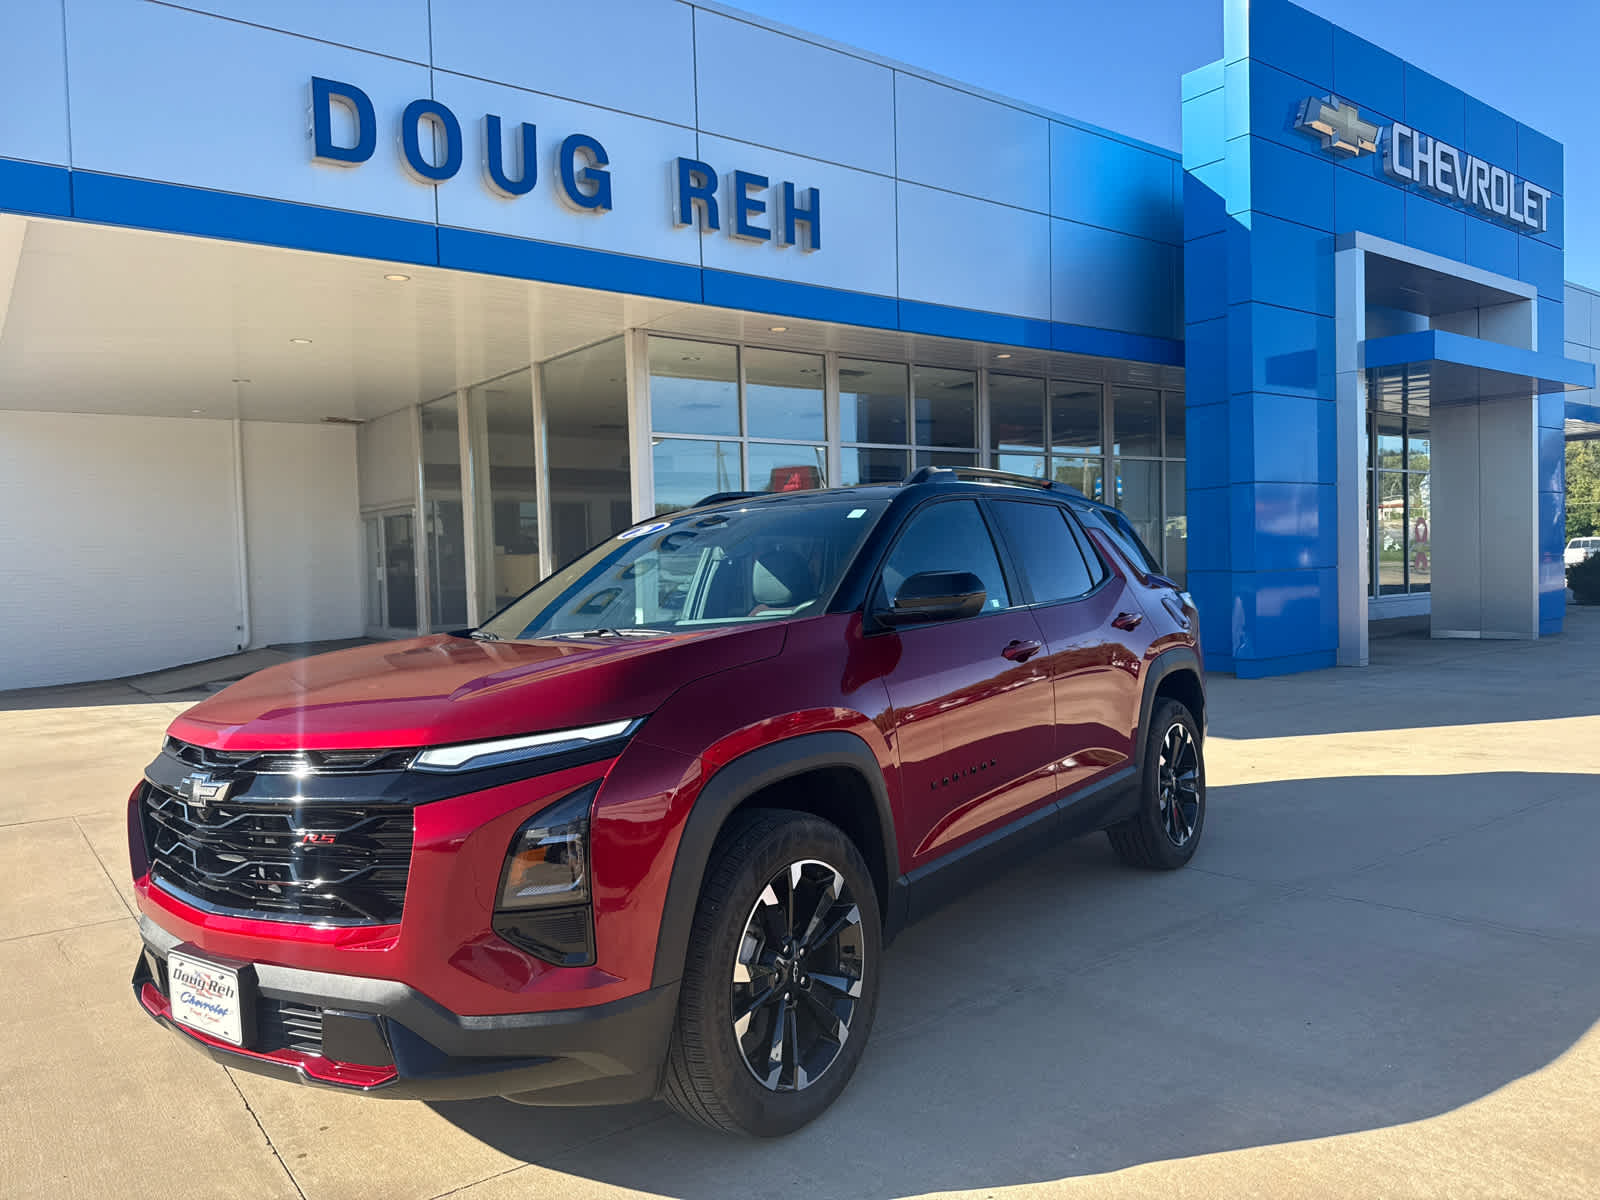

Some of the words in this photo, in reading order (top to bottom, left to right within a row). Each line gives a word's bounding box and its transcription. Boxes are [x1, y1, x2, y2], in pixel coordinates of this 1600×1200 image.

[310, 76, 613, 214] DOUG
[674, 156, 822, 252] REH
[1391, 121, 1552, 233] CHEVROLET
[302, 833, 337, 845] RS
[172, 968, 206, 991] Doug
[208, 980, 235, 998] Reh
[180, 991, 229, 1016] Chevrolet
